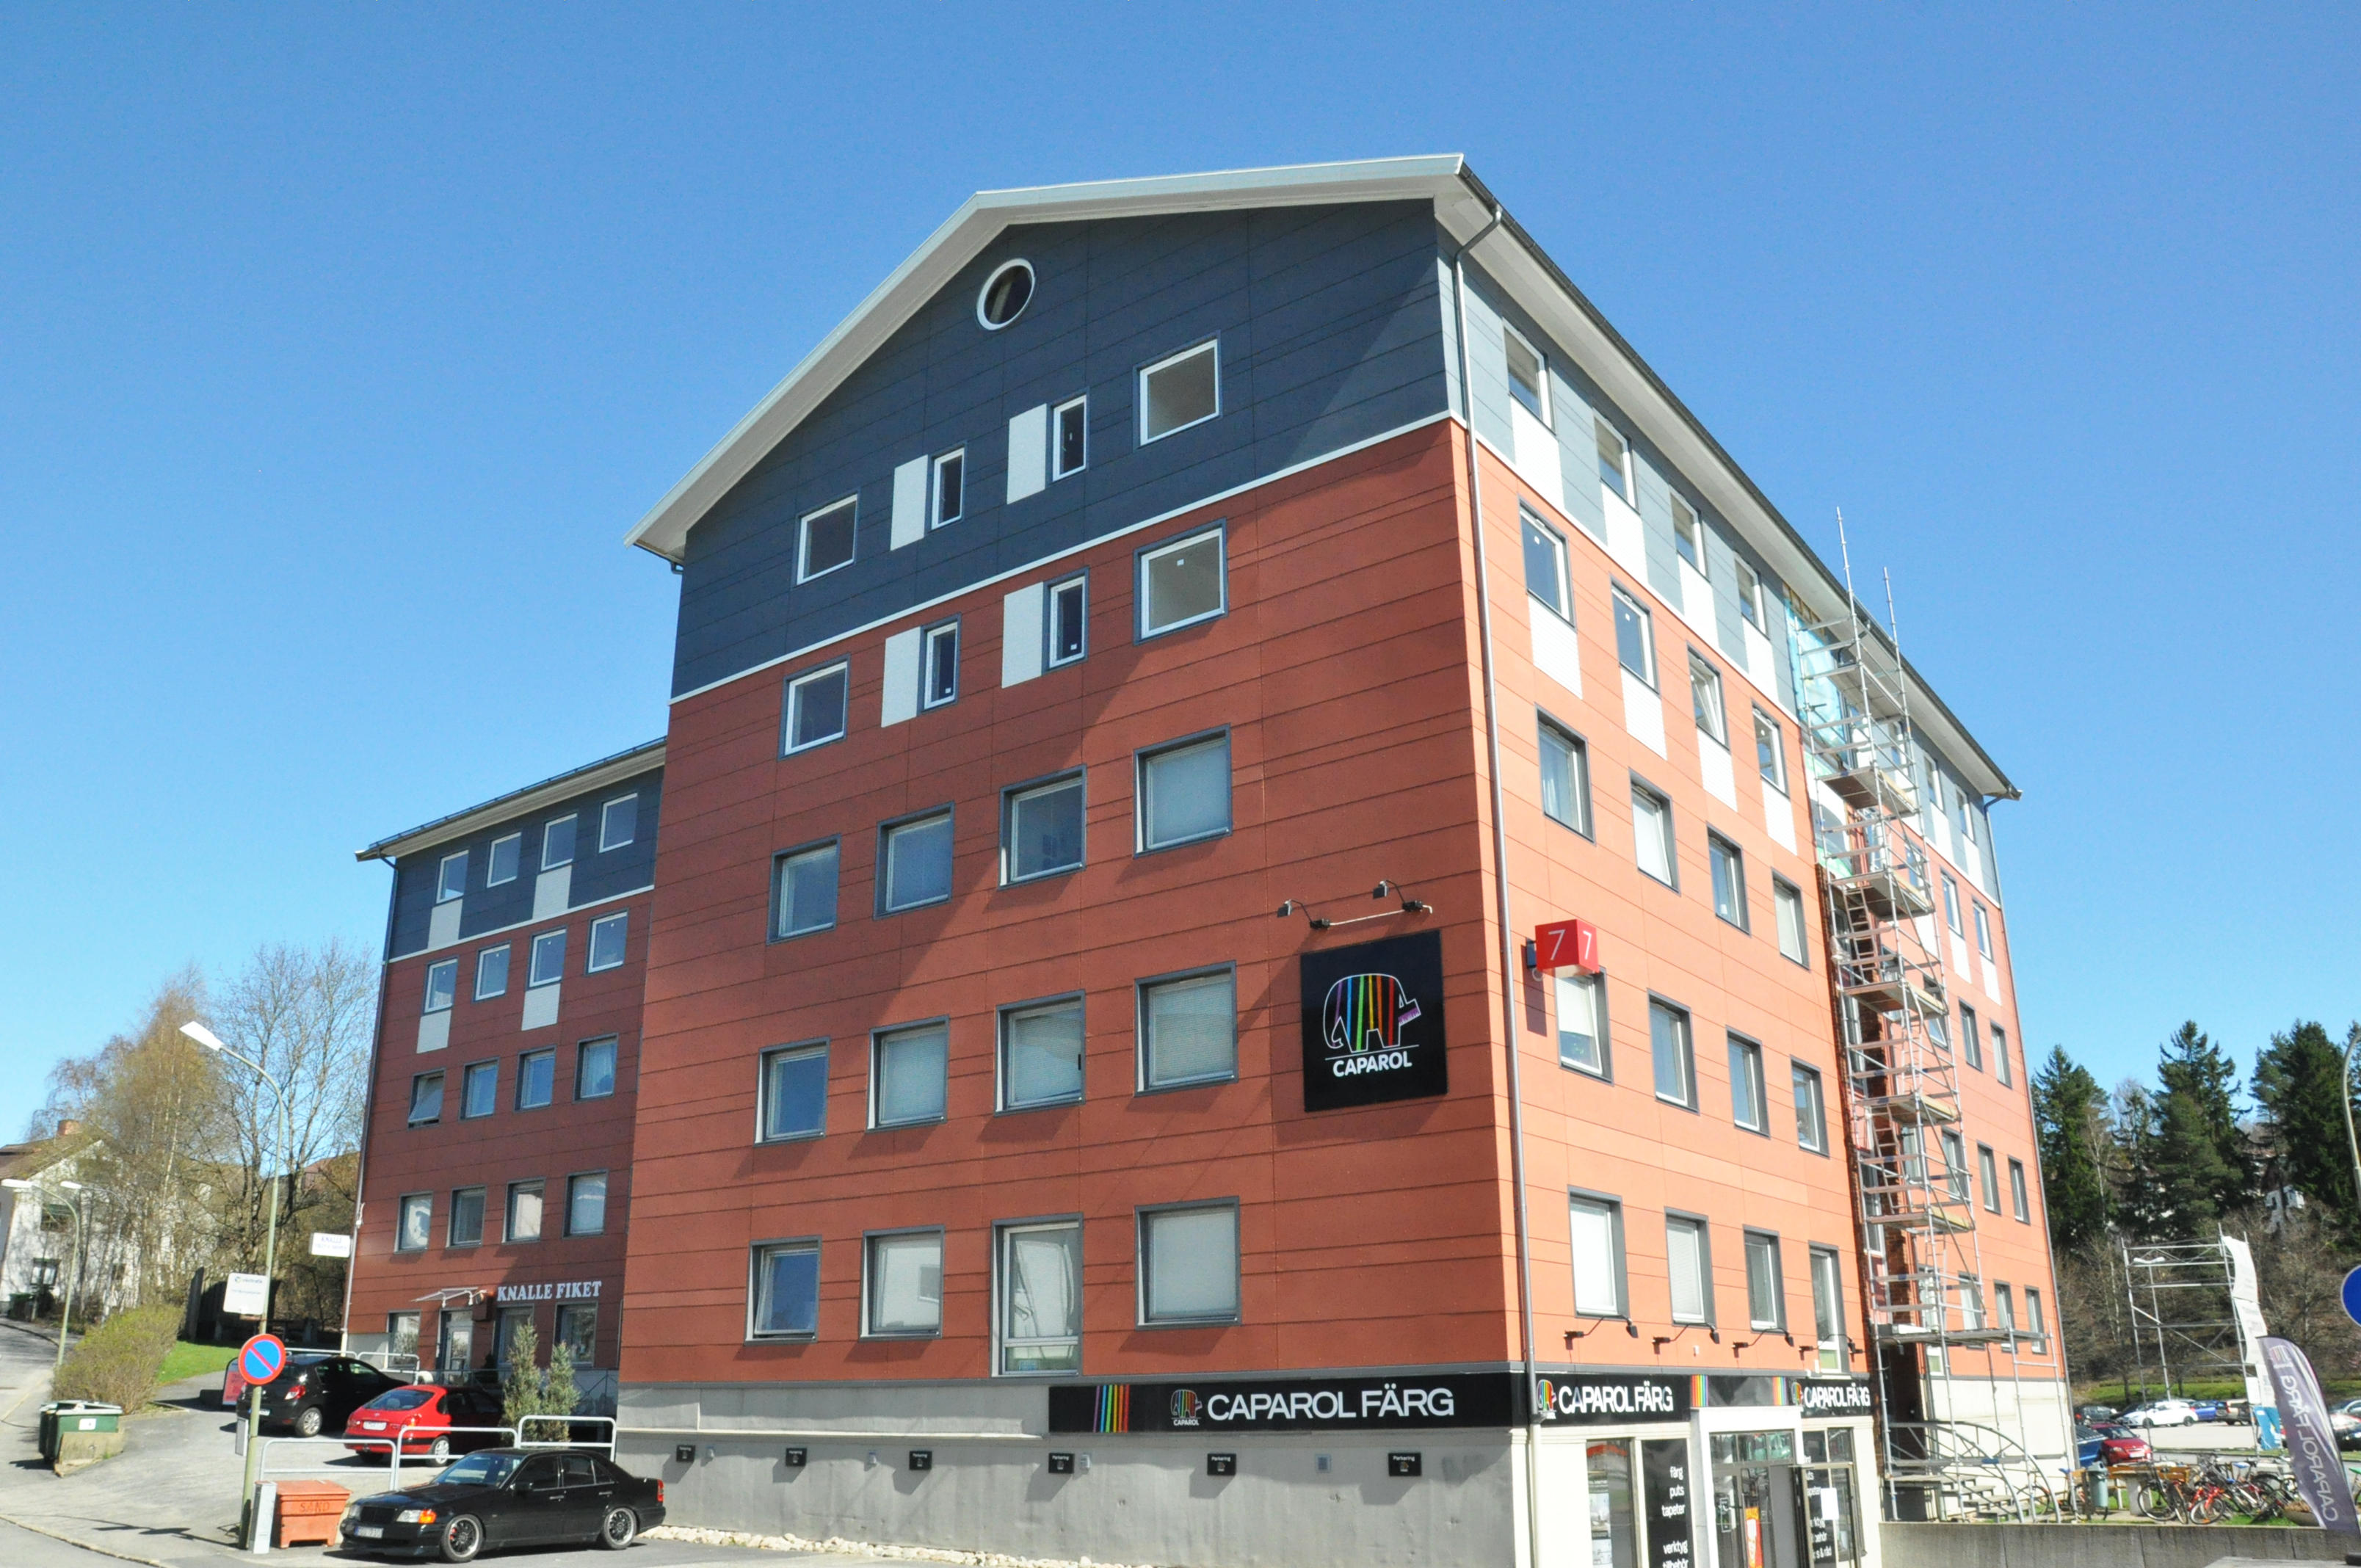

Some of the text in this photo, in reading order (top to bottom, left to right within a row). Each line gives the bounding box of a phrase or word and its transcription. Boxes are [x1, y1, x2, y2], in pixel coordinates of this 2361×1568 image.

[1548, 929, 1566, 961] 7
[1583, 930, 1592, 960] 7
[1332, 1050, 1412, 1078] CAPAROL
[496, 1280, 602, 1302] KNALLE FIKET
[1207, 1382, 1455, 1420] CAPAROL FÄRG
[1558, 1380, 1674, 1415] CAPAROL FÄRG
[1804, 1382, 1871, 1409] CAPAROL FÄRG
[1173, 1418, 1200, 1426] CAPAROL
[1669, 1466, 1684, 1481] färg
[1669, 1484, 1685, 1500] puts
[1807, 1486, 1821, 1498] apeter
[300, 1501, 330, 1513] SAND
[1661, 1503, 1686, 1518] tapeter
[1663, 1540, 1689, 1555] verktyg
